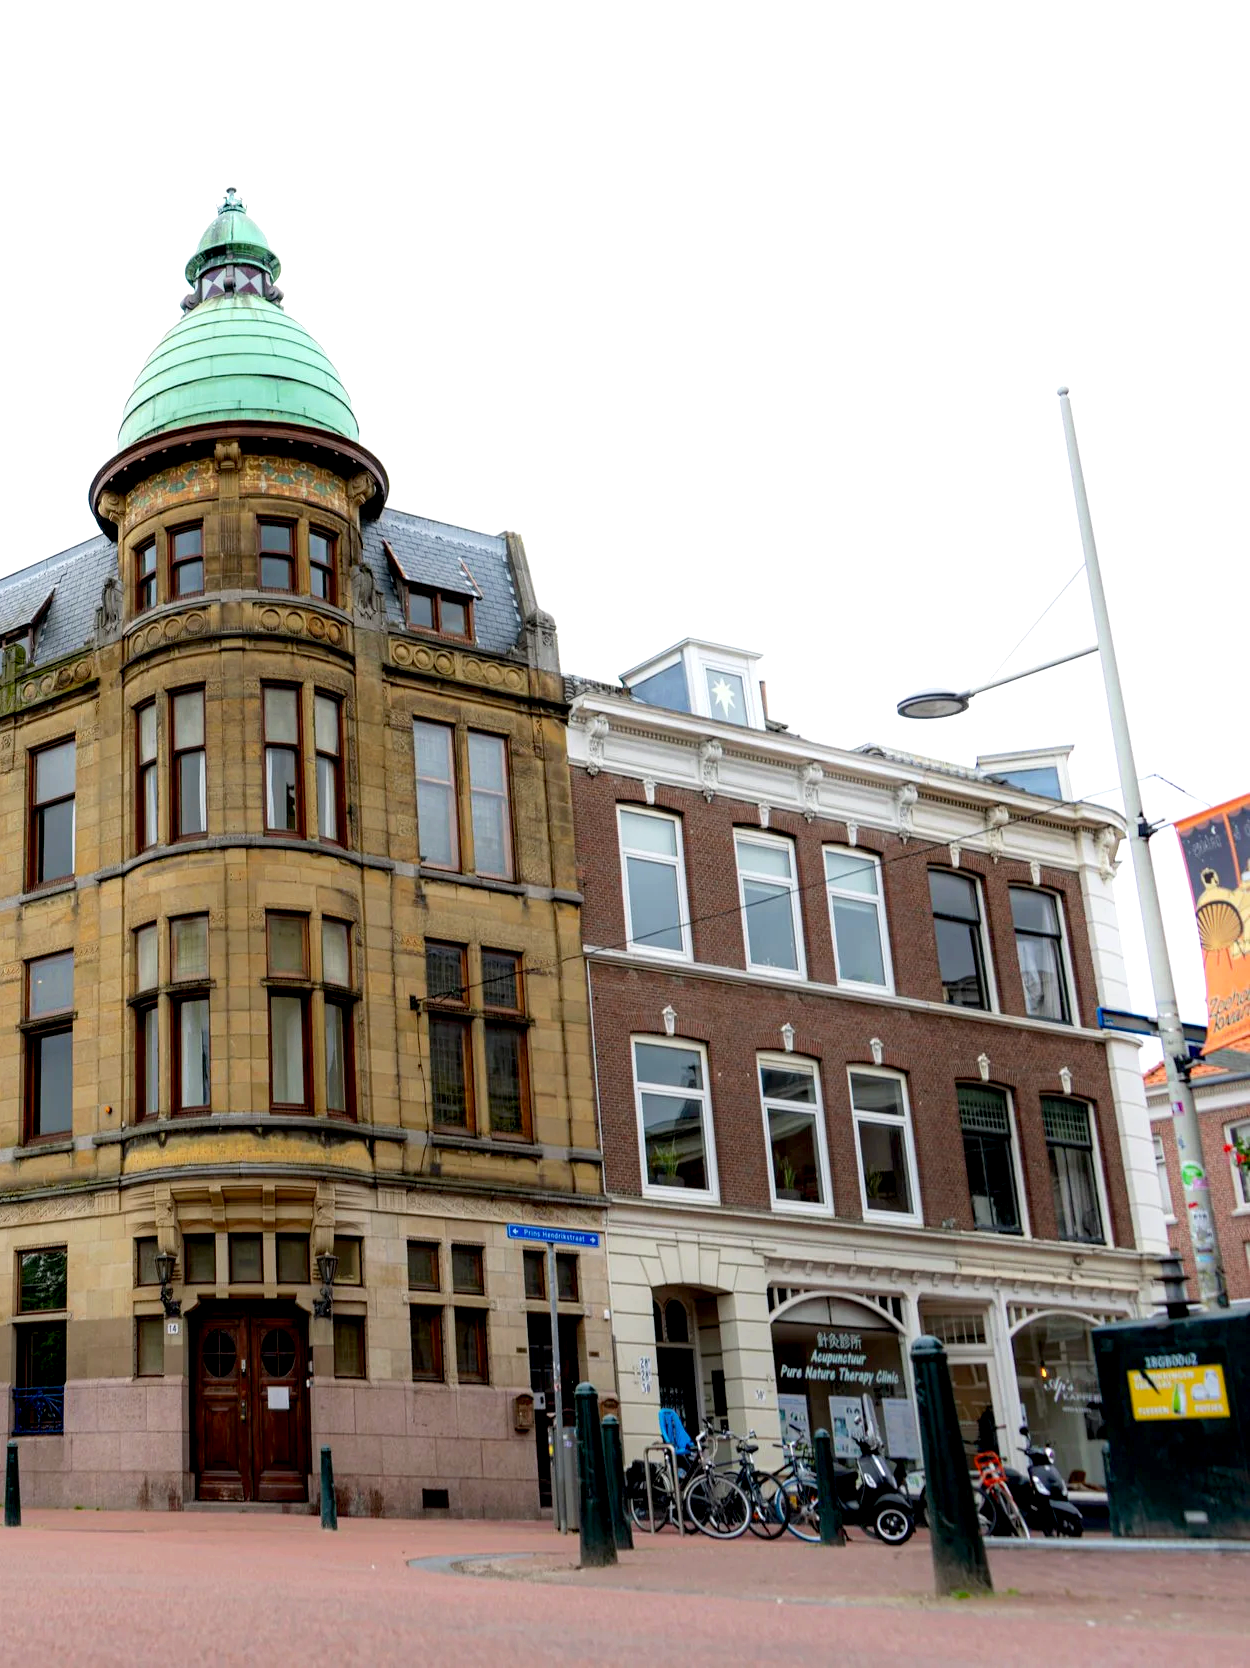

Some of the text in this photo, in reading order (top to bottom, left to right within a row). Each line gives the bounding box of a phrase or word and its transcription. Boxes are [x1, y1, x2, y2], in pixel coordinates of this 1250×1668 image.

[523, 1228, 585, 1243] Prins Hendrikstraat
[810, 1349, 867, 1367] Acupunctuur
[780, 1363, 899, 1386] Pure Nature Therapy Clinic
